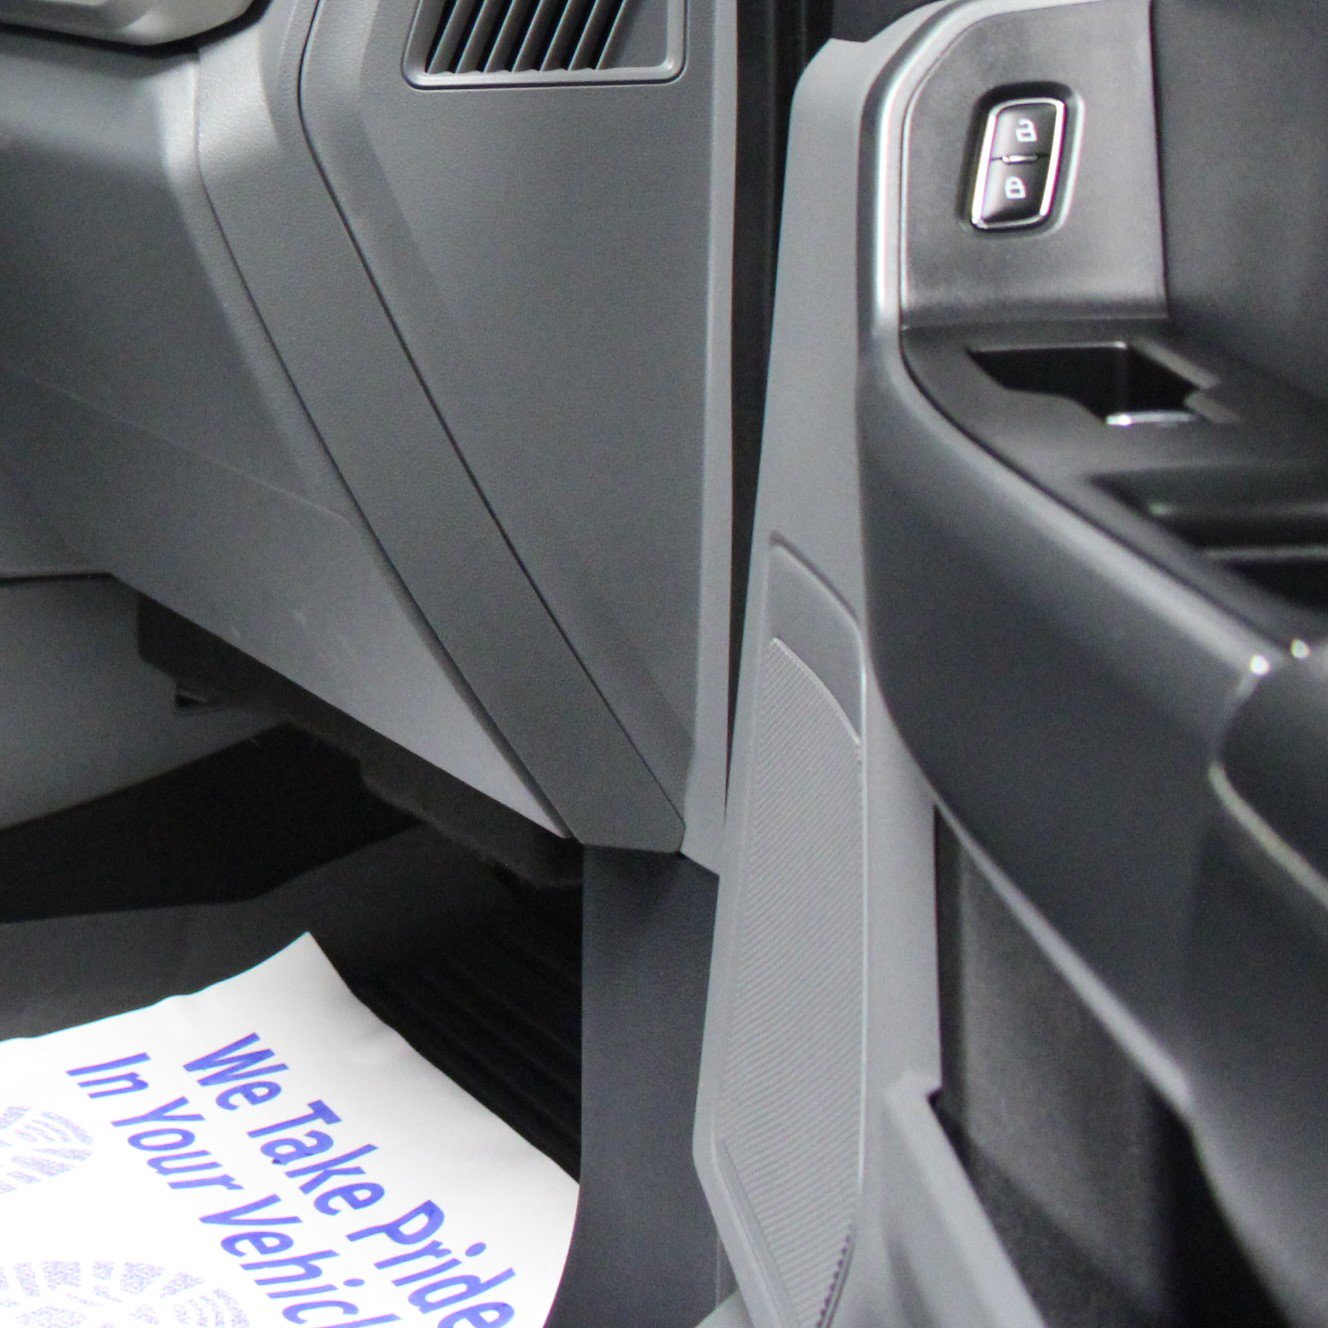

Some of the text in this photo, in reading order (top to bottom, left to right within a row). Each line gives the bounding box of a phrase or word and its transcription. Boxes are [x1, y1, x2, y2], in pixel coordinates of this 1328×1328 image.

[65, 1052, 151, 1100] In
[110, 1096, 244, 1191] Your
[182, 1031, 516, 1328] We Take Pride
